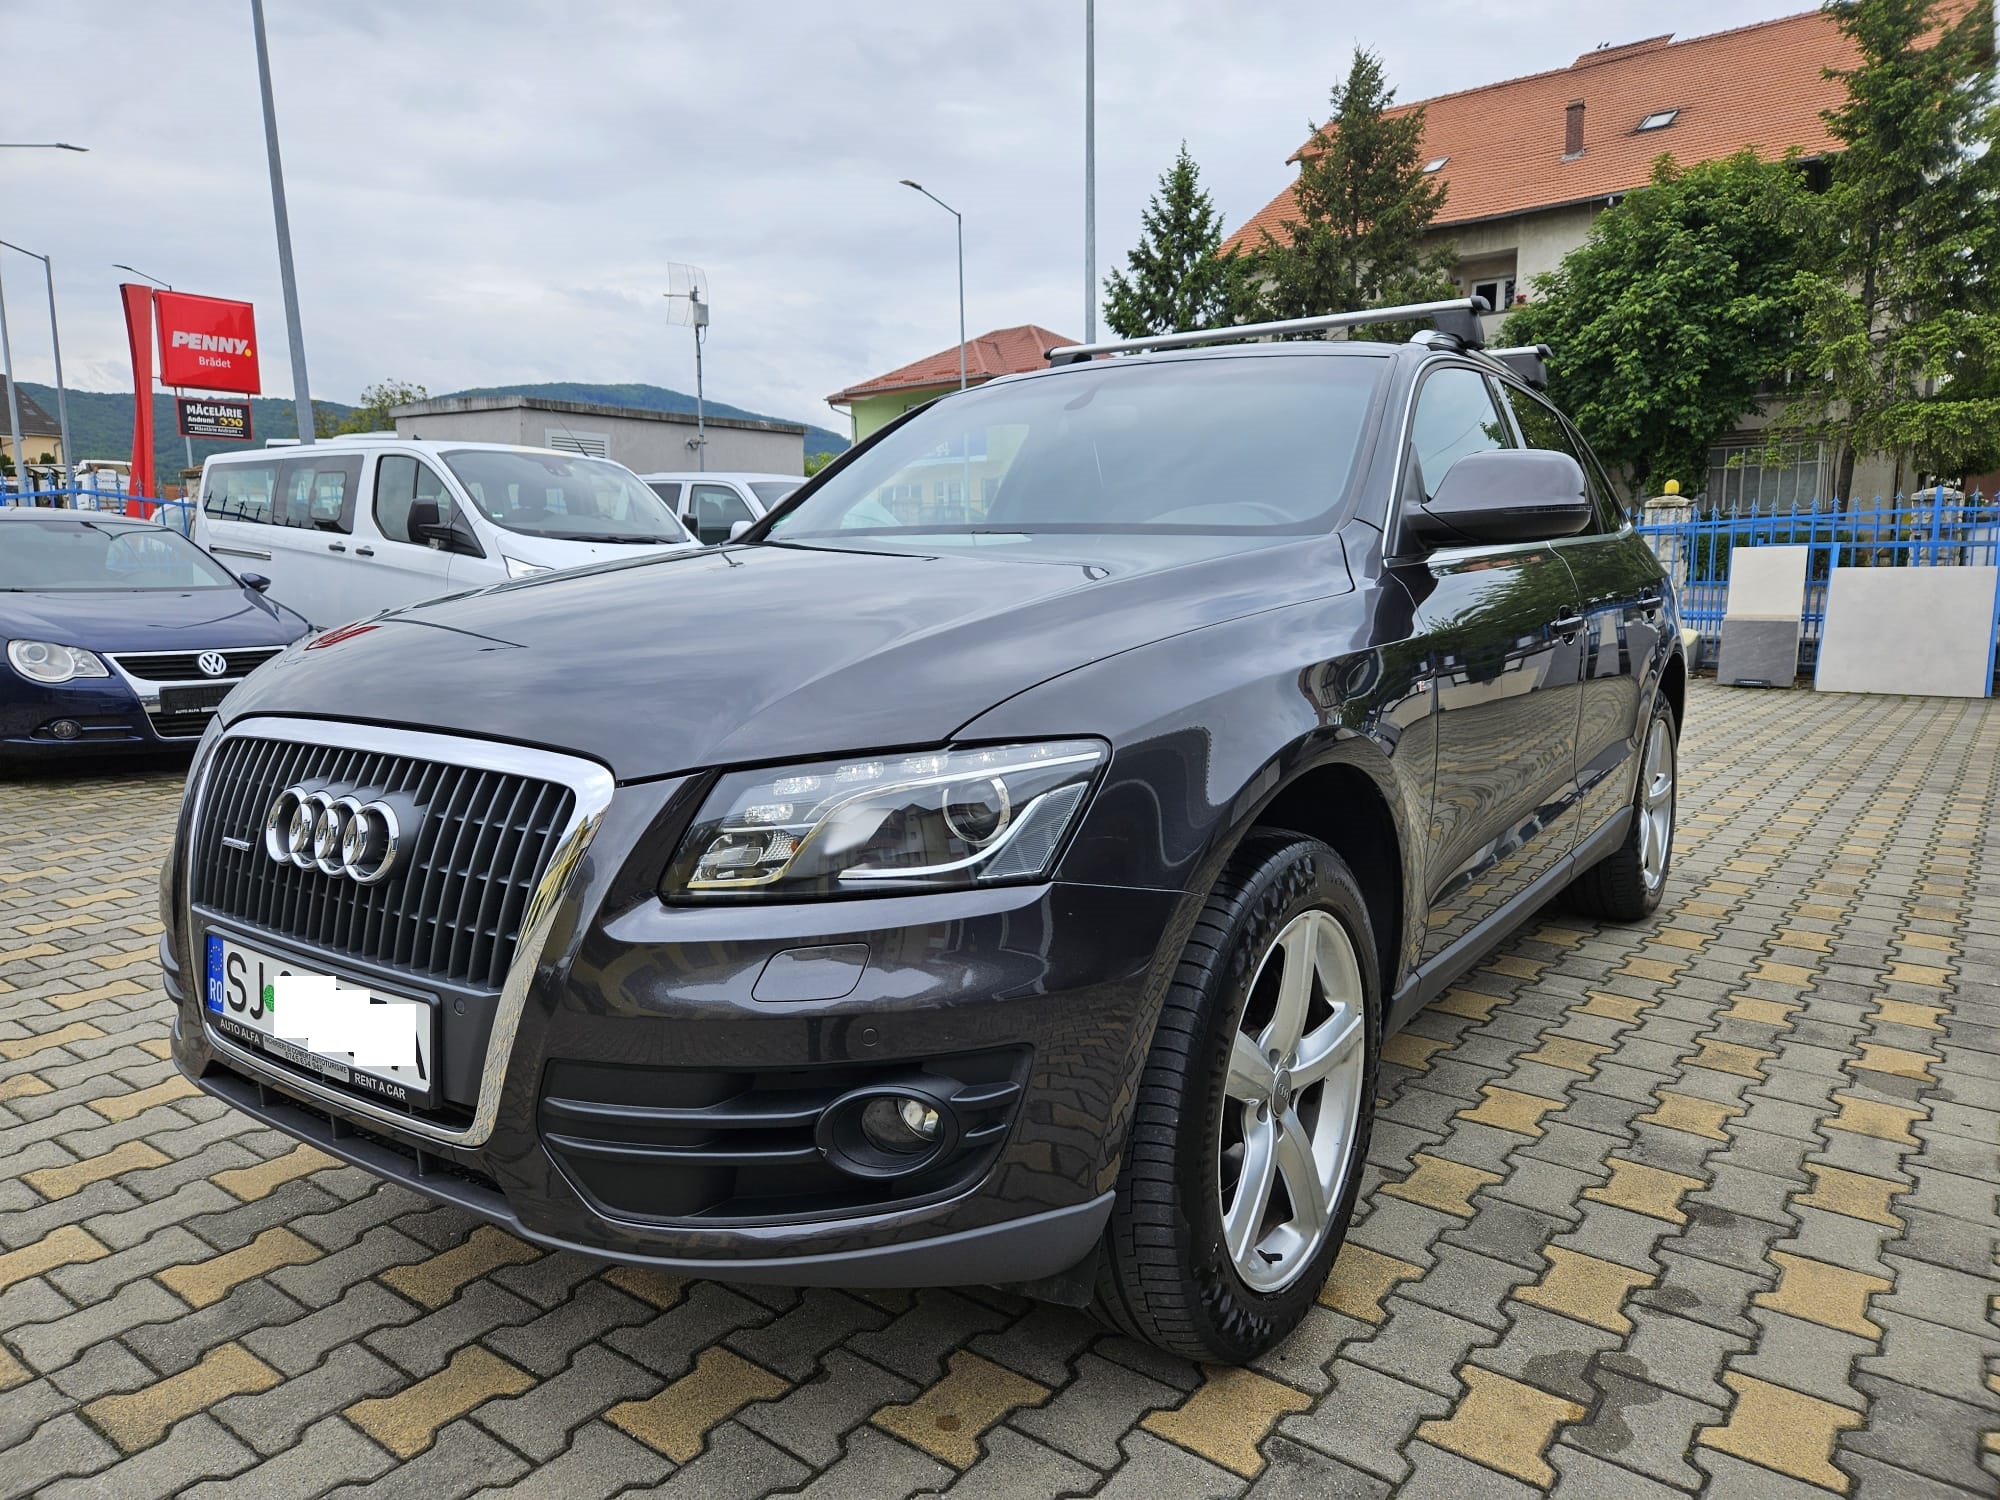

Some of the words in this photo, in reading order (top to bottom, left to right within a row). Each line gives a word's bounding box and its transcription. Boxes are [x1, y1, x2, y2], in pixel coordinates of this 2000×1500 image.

[199, 356, 231, 368] Brădet
[186, 403, 243, 419] MĂCELĂRIE
[209, 977, 223, 1004] RO
[220, 1018, 240, 1036] AUTO
[241, 1027, 260, 1045] ALFA
[354, 1072, 377, 1090] RENT
[378, 1081, 386, 1094] A
[386, 1083, 407, 1100] CAR
